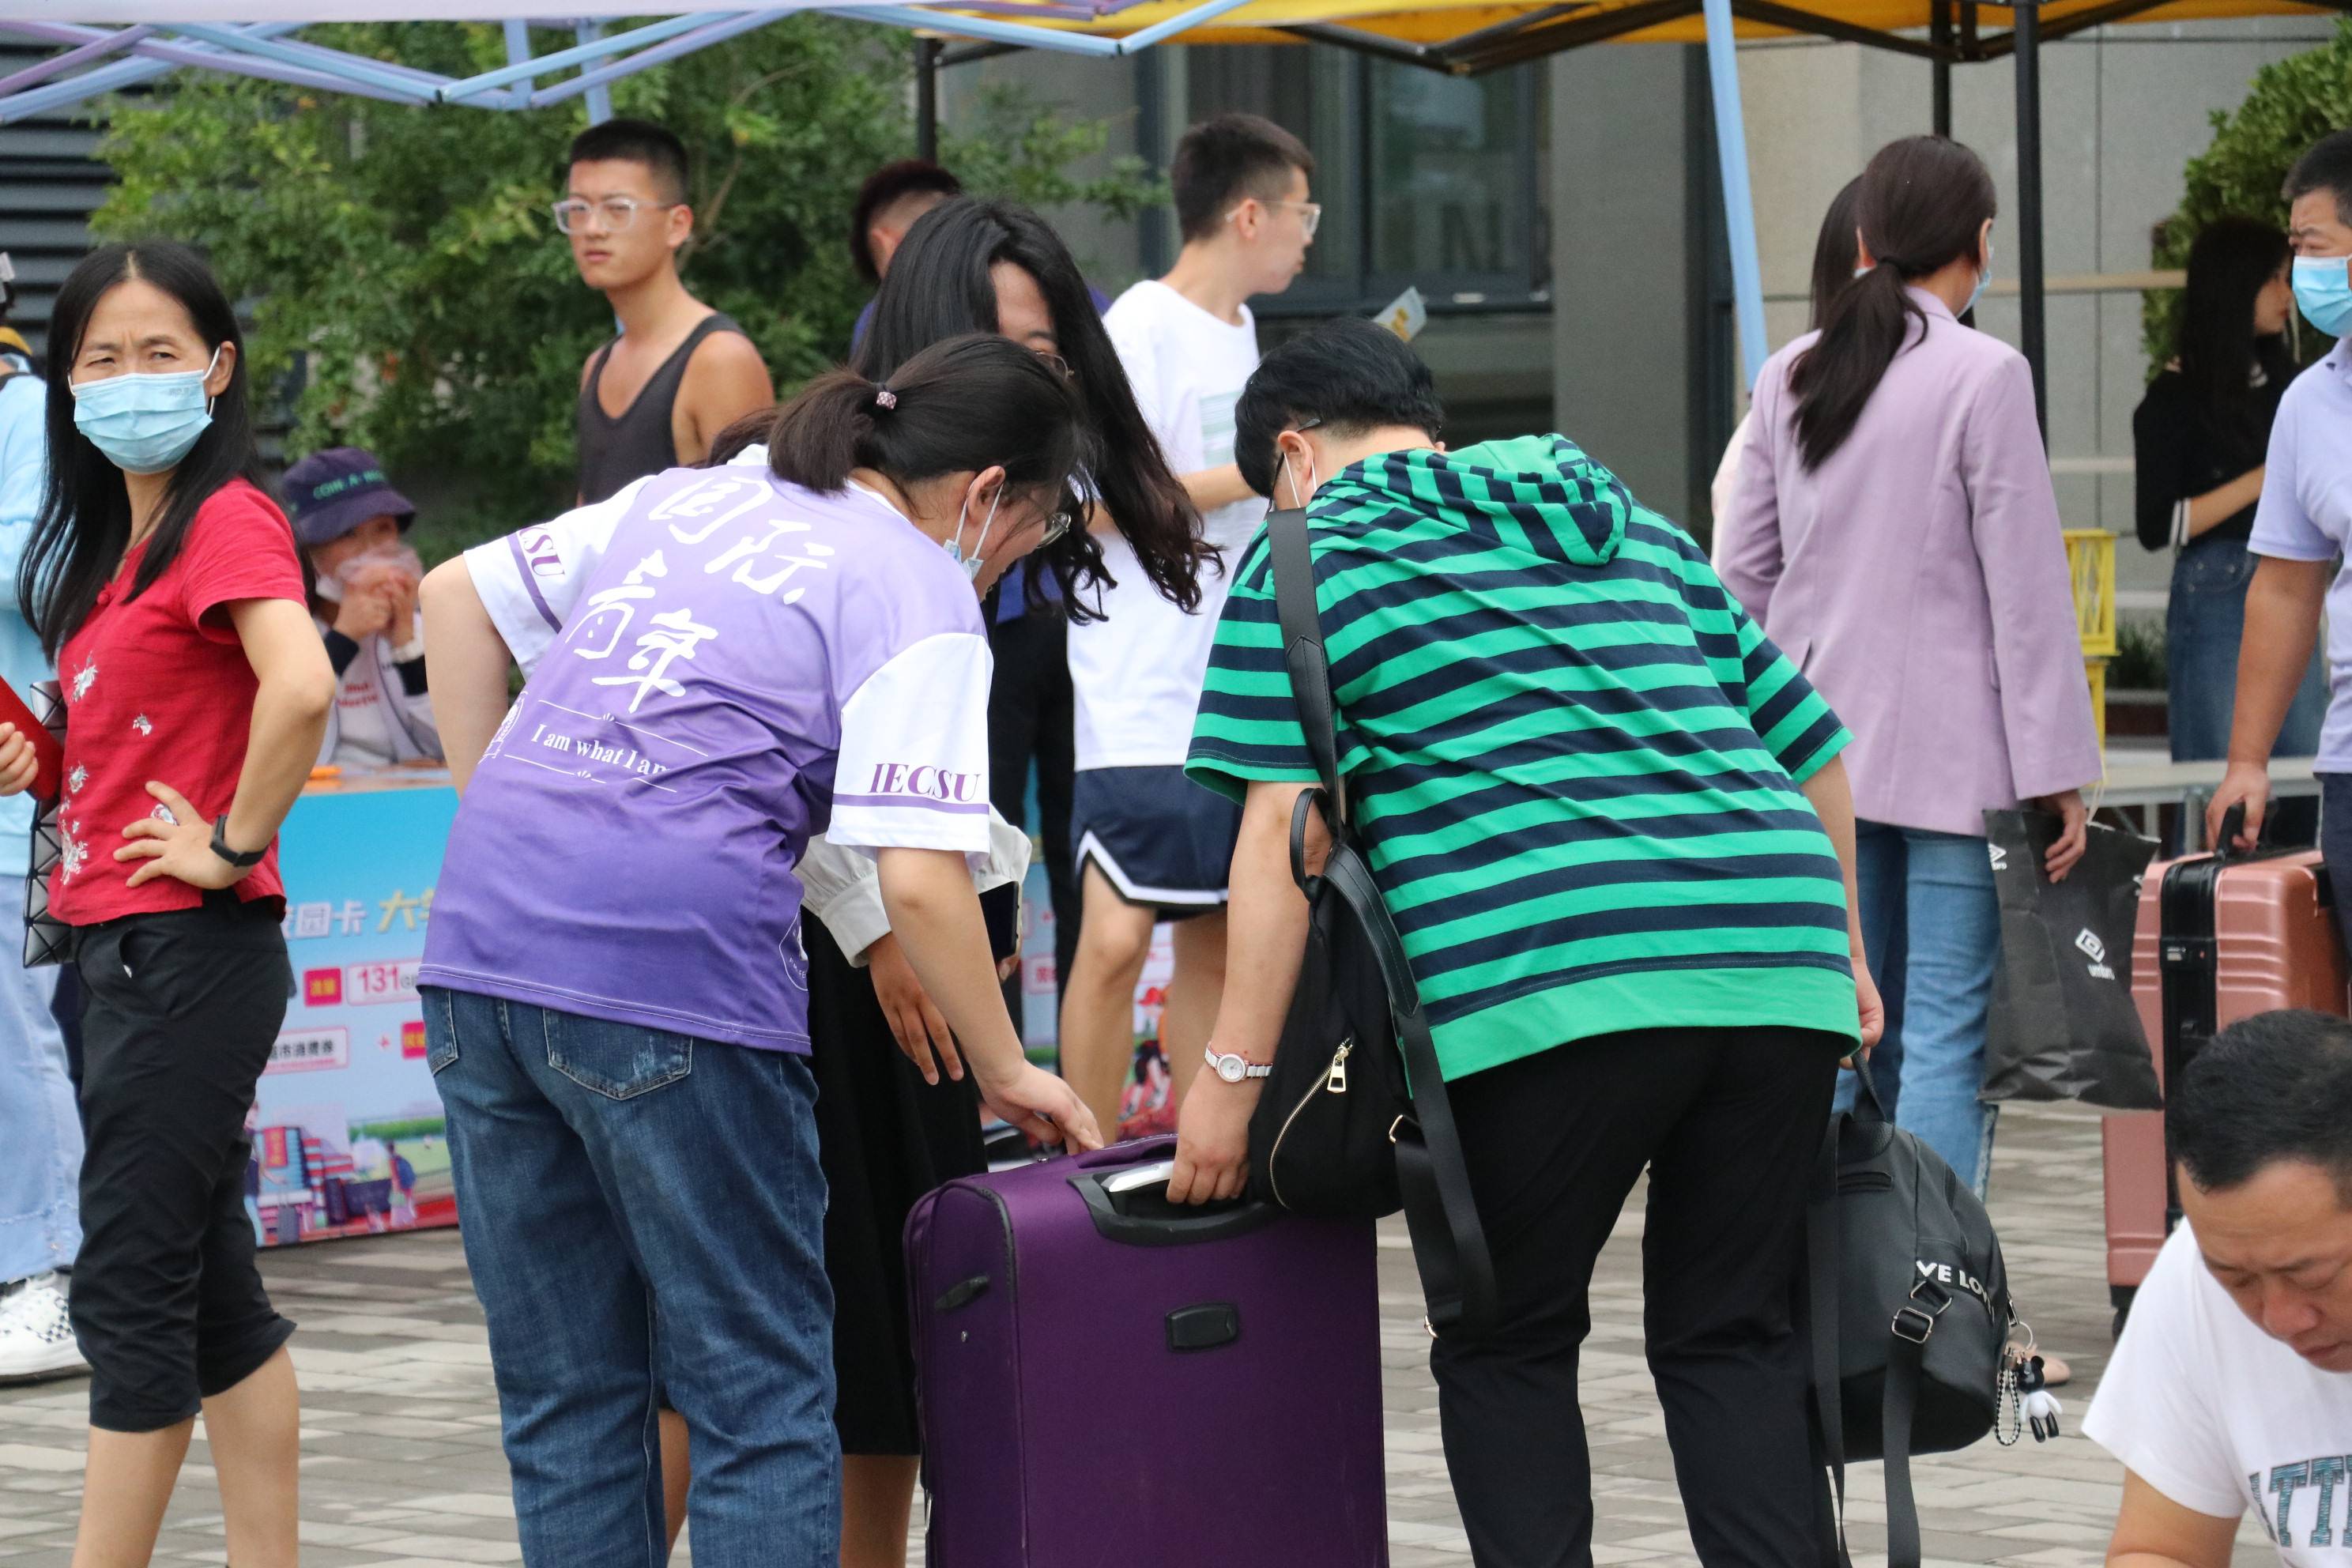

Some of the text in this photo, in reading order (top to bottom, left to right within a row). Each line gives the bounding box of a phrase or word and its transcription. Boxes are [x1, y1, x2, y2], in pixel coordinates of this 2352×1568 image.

[531, 723, 547, 743] I
[543, 733, 571, 752] am
[576, 740, 624, 764] what
[623, 749, 638, 769] I
[869, 763, 981, 802] IECSU
